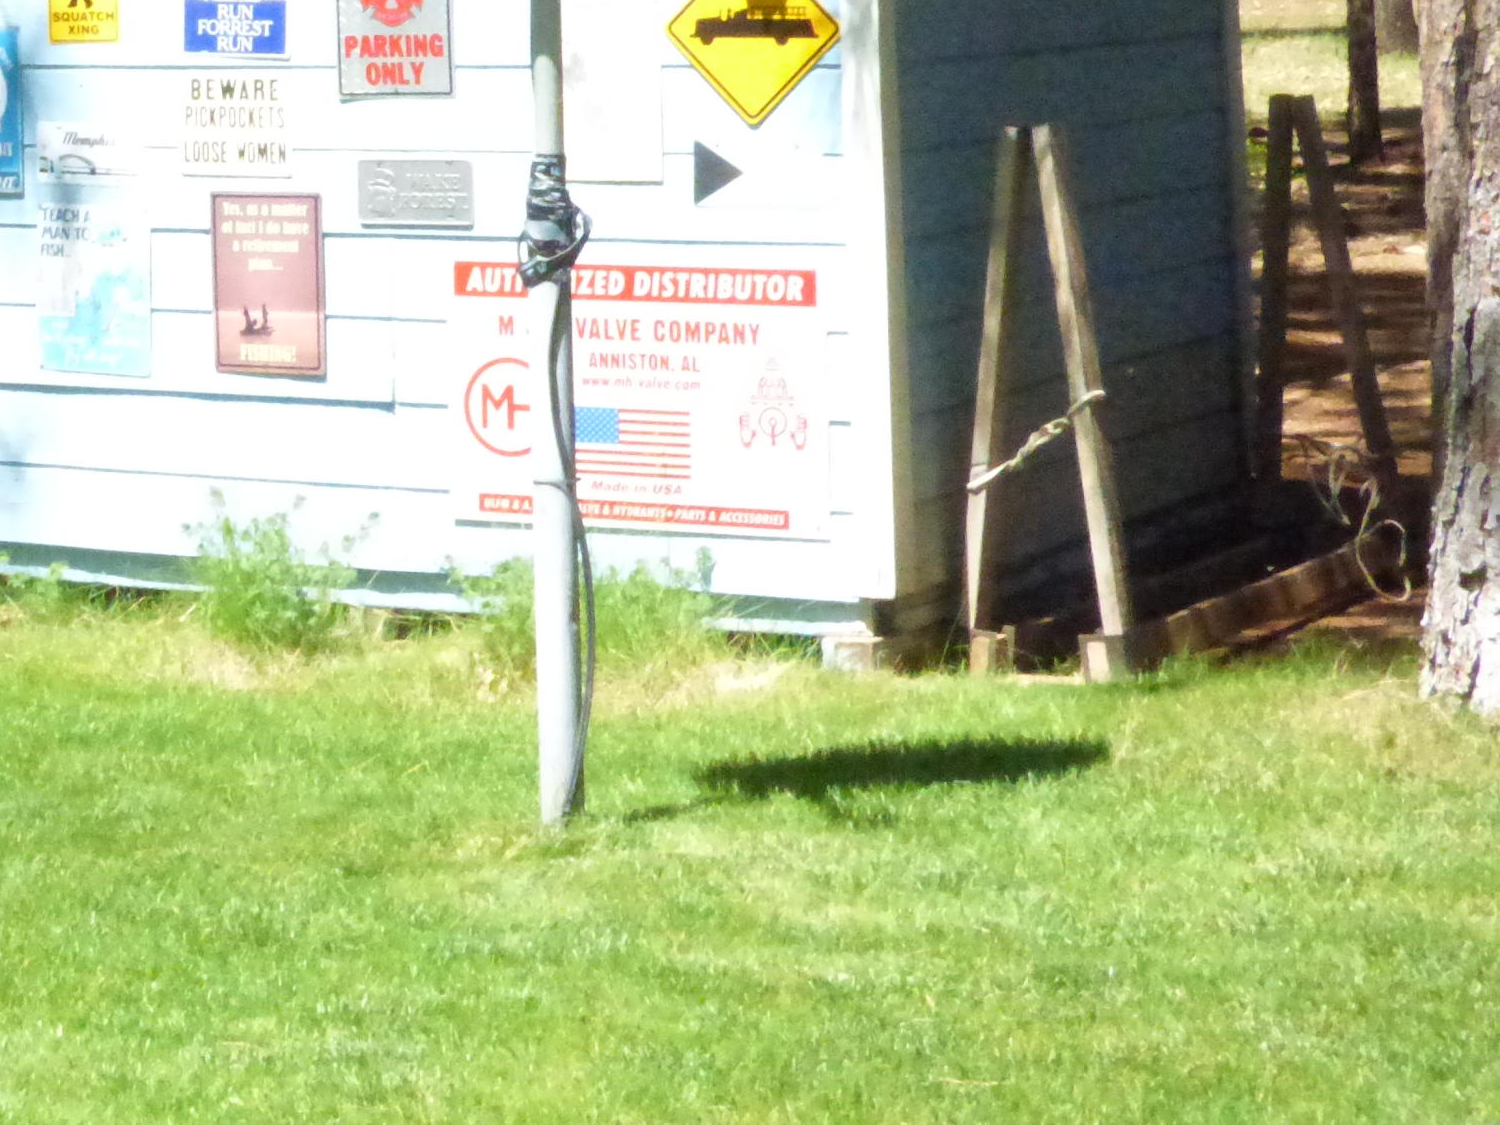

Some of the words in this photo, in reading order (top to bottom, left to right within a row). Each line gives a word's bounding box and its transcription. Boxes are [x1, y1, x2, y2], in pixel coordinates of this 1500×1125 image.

[53, 11, 114, 22] SQUATCH
[217, 3, 253, 20] RUN
[68, 25, 99, 35] XING
[197, 19, 274, 37] FORREST
[217, 35, 253, 52] RUN
[344, 34, 444, 59] PARKING
[366, 62, 424, 86] ONLY
[191, 79, 278, 101] BEWARE
[185, 106, 285, 128] PICKPOCKETS
[184, 141, 227, 163] LOOSE
[237, 141, 287, 164] WOMEN
[42, 207, 80, 223] TEACH
[41, 226, 70, 240] MAN
[465, 266, 625, 296] AUTIZED
[633, 270, 805, 301] DISTRIBUTOR
[498, 315, 514, 336] M
[575, 317, 641, 343] VALVE
[654, 320, 760, 346] COMPANY
[681, 354, 701, 373] AL
[591, 480, 628, 493] Made
[634, 482, 647, 493] in
[653, 483, 684, 496] USA
[613, 505, 665, 519] HYDRANTS
[674, 509, 706, 522] PARTS
[708, 511, 717, 523] &
[719, 512, 786, 526] ACCESSORIES
